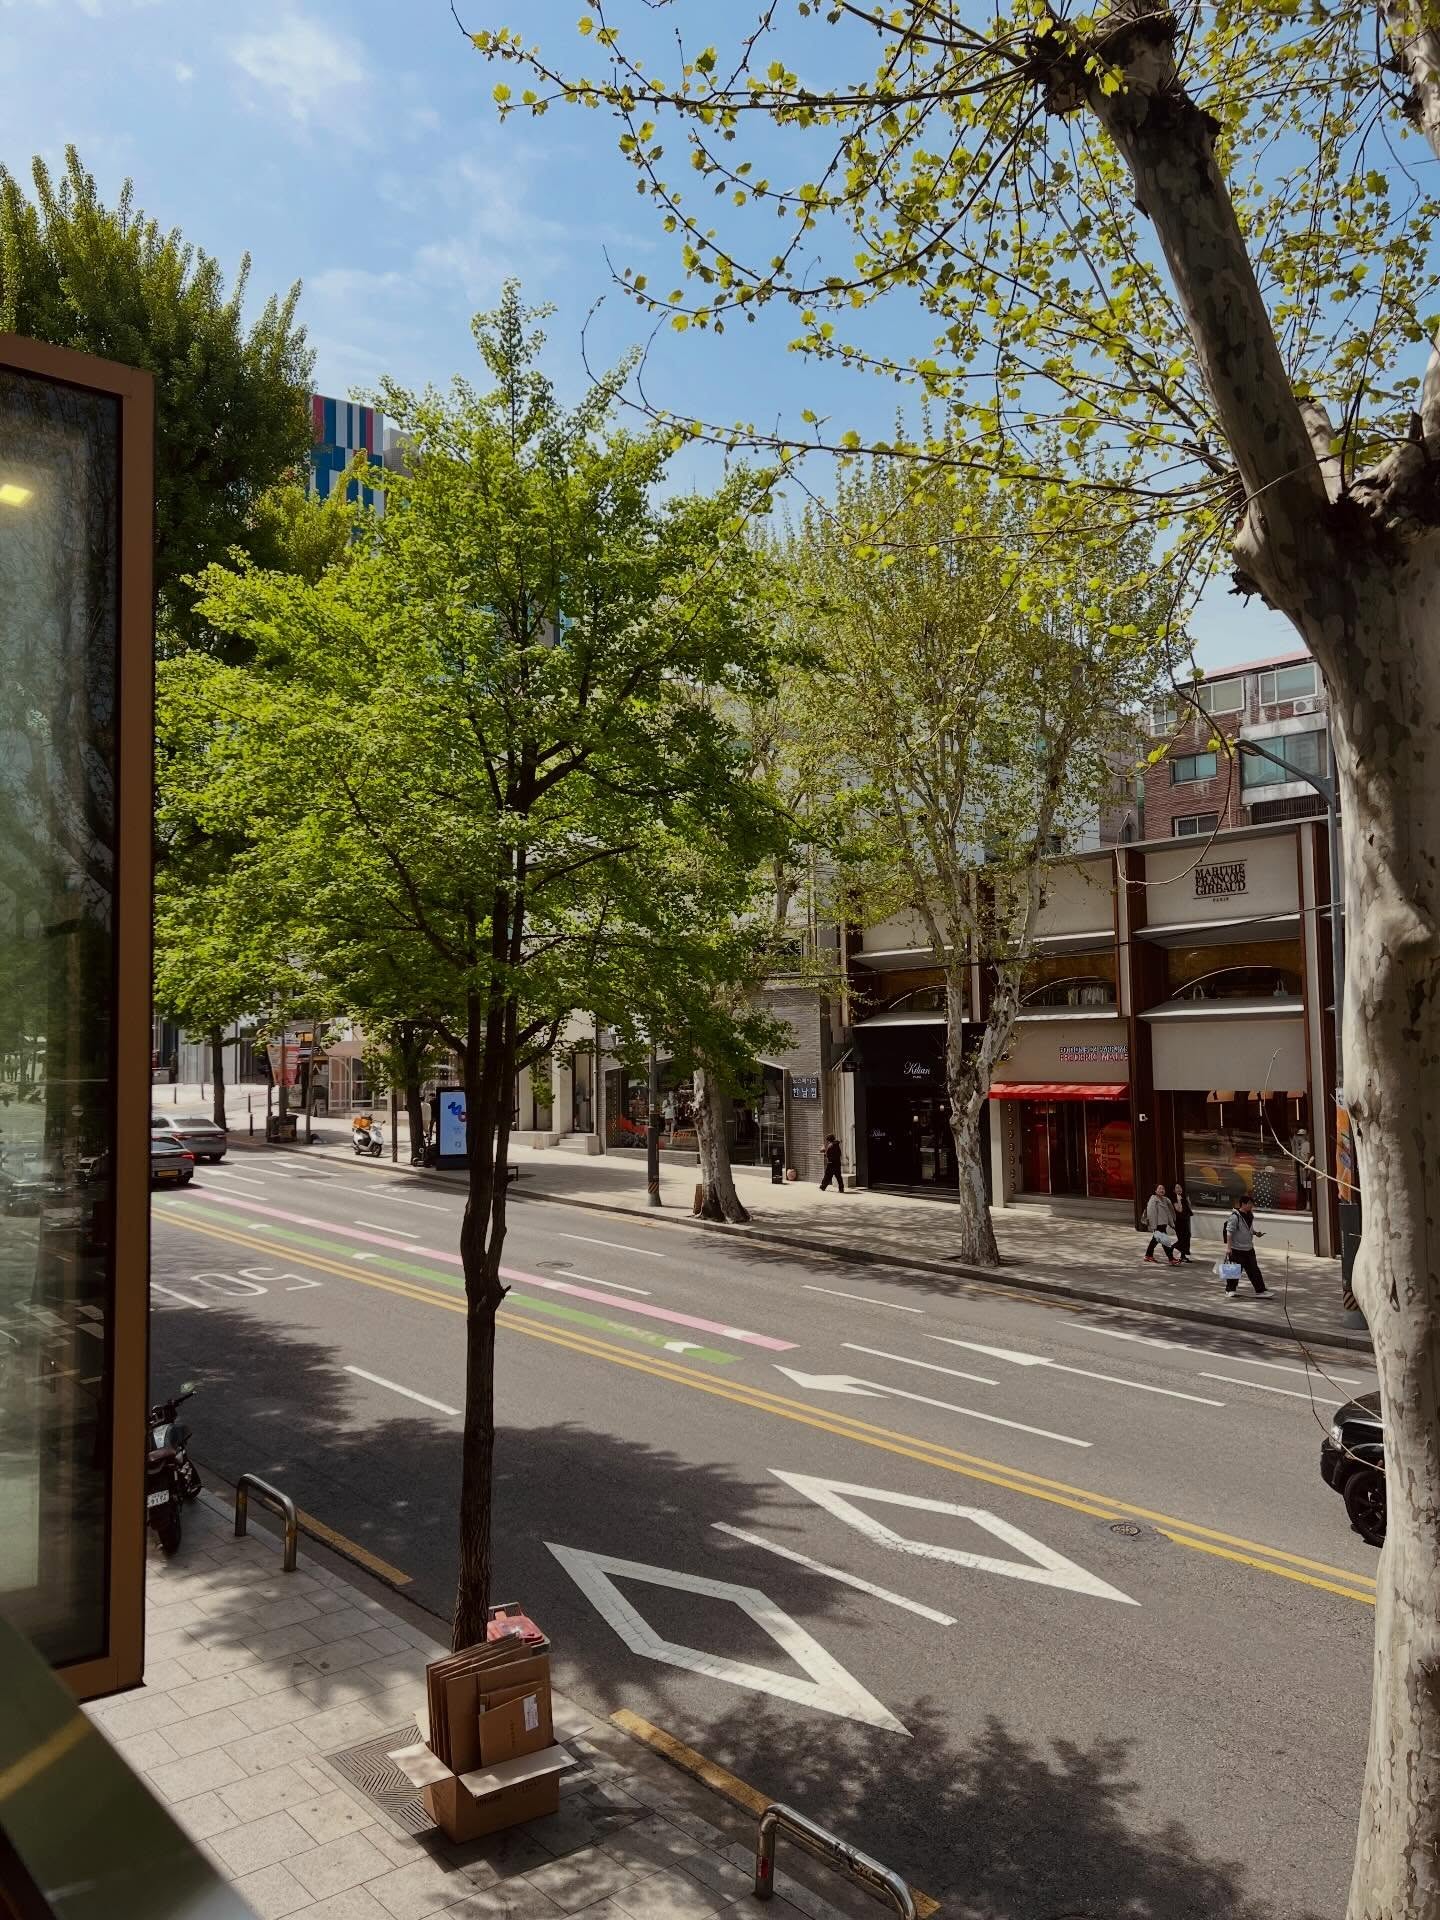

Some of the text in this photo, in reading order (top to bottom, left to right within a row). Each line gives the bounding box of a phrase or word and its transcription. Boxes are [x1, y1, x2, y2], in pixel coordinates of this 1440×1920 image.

[1196, 881, 1246, 896] GIRBAUD
[793, 1087, 816, 1098] 한남점
[188, 1267, 324, 1297] 50
